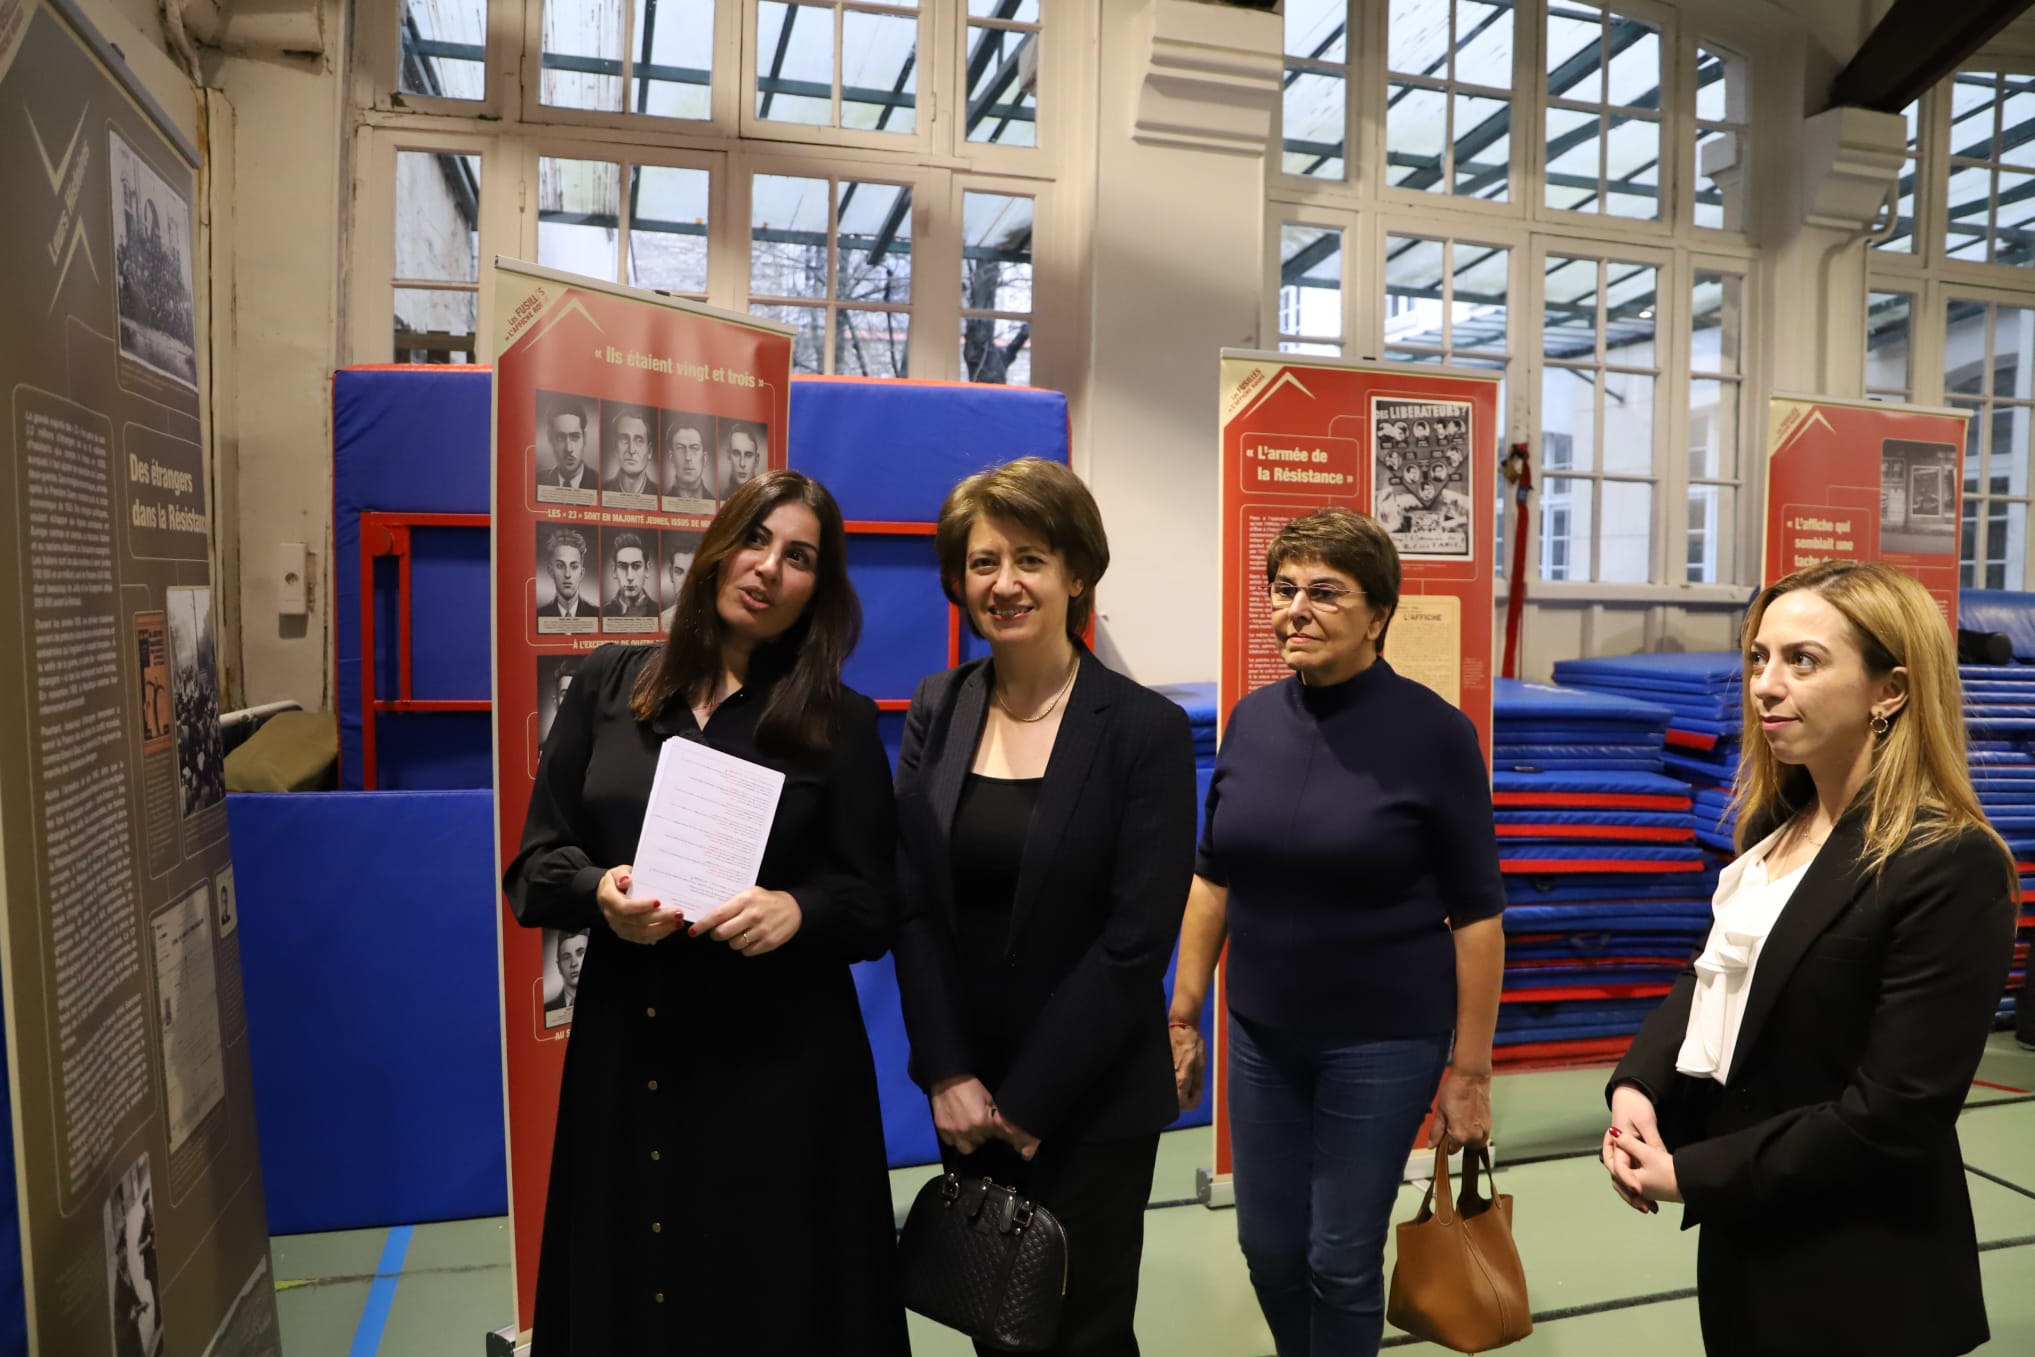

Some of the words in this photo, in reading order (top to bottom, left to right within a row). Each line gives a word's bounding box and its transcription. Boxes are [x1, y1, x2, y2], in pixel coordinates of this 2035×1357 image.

[606, 345, 623, 364] Ils
[627, 349, 673, 374] étaient
[675, 360, 709, 382] vingt
[712, 368, 725, 382] et
[727, 370, 755, 388] trois
[1257, 445, 1308, 462] L'armée
[1311, 448, 1328, 463] de
[130, 453, 149, 484] Des
[151, 457, 193, 497] étrangers
[1257, 466, 1270, 481] la
[1274, 467, 1343, 484] Résistance
[132, 498, 157, 528] dans
[158, 502, 167, 529] la
